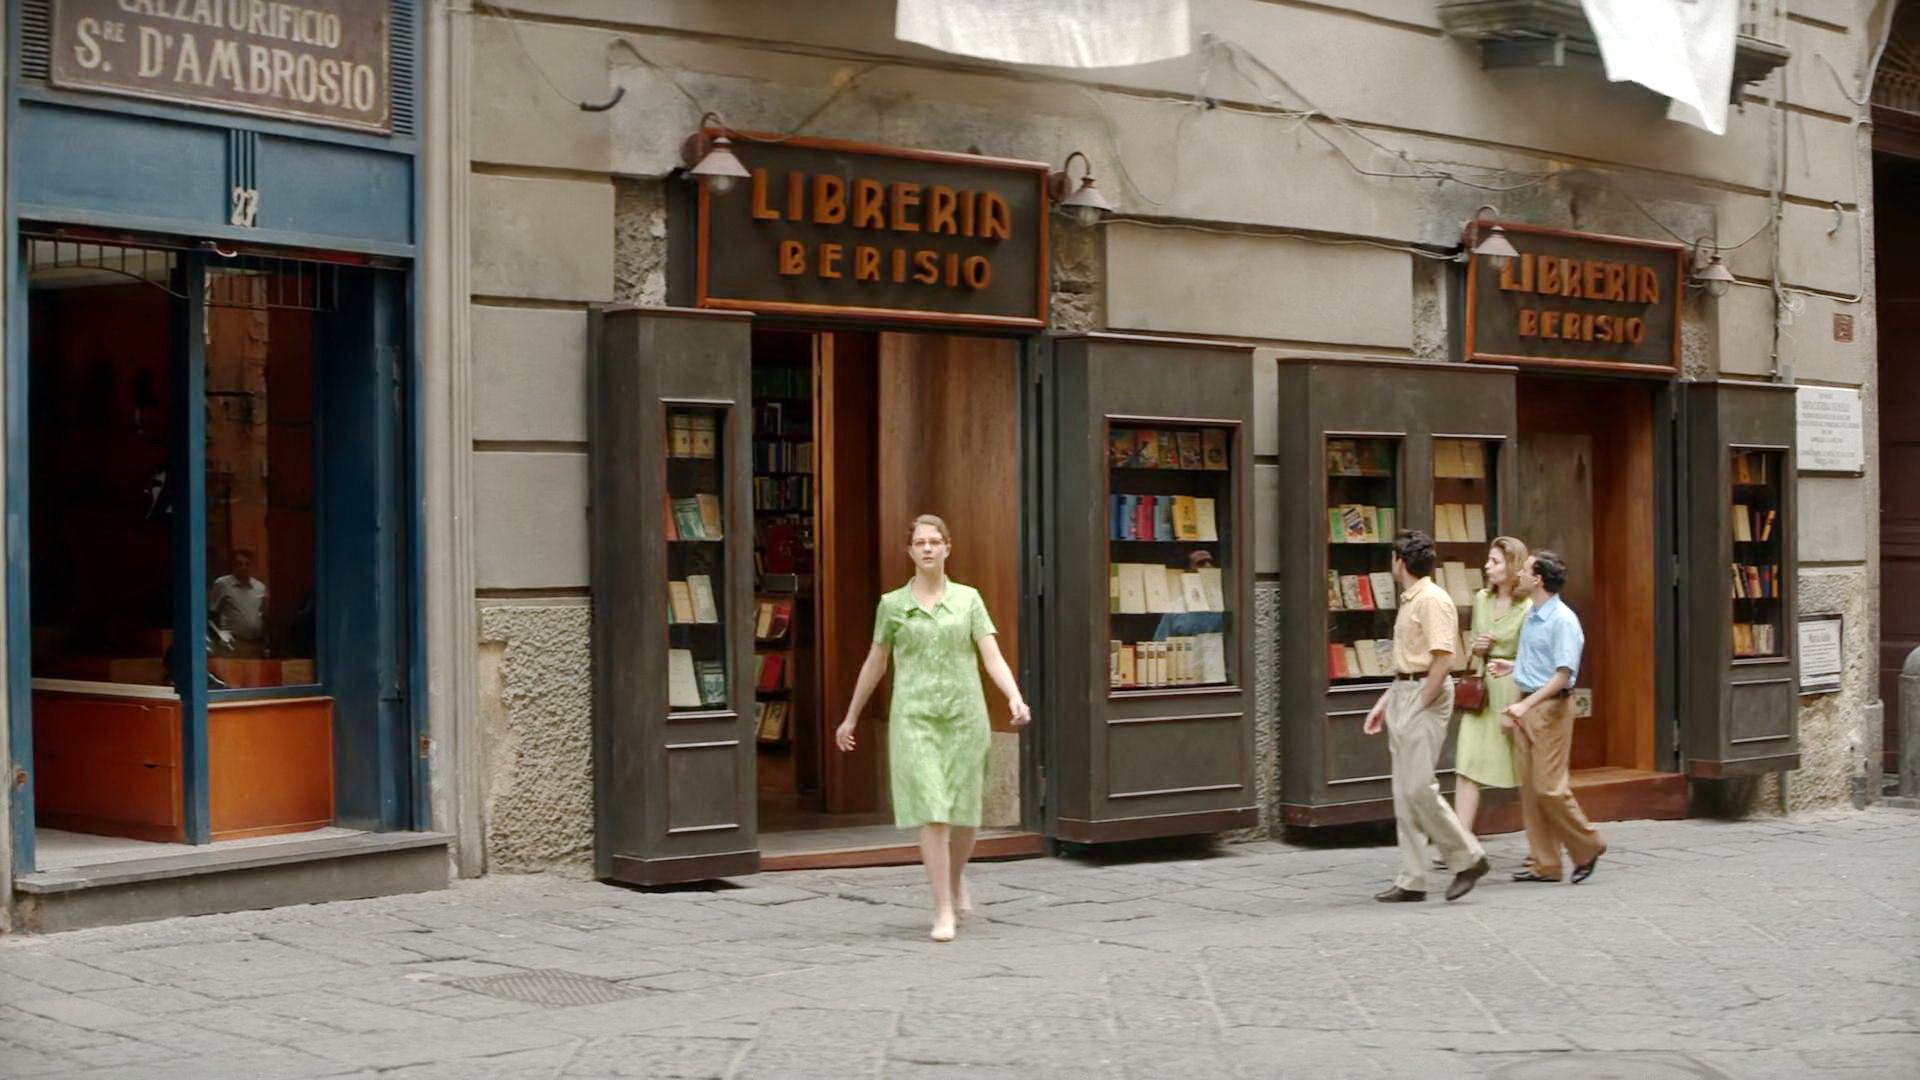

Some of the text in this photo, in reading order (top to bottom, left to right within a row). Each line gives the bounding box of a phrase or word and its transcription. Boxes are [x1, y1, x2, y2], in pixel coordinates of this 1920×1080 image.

[137, 25, 376, 112] D'AMBROSIO
[231, 187, 258, 227] 27
[751, 167, 1014, 241] LIBRERIA
[777, 239, 992, 290] BERISIO
[1499, 252, 1660, 305] LIBRERIA
[1518, 308, 1647, 344] BERISIO
